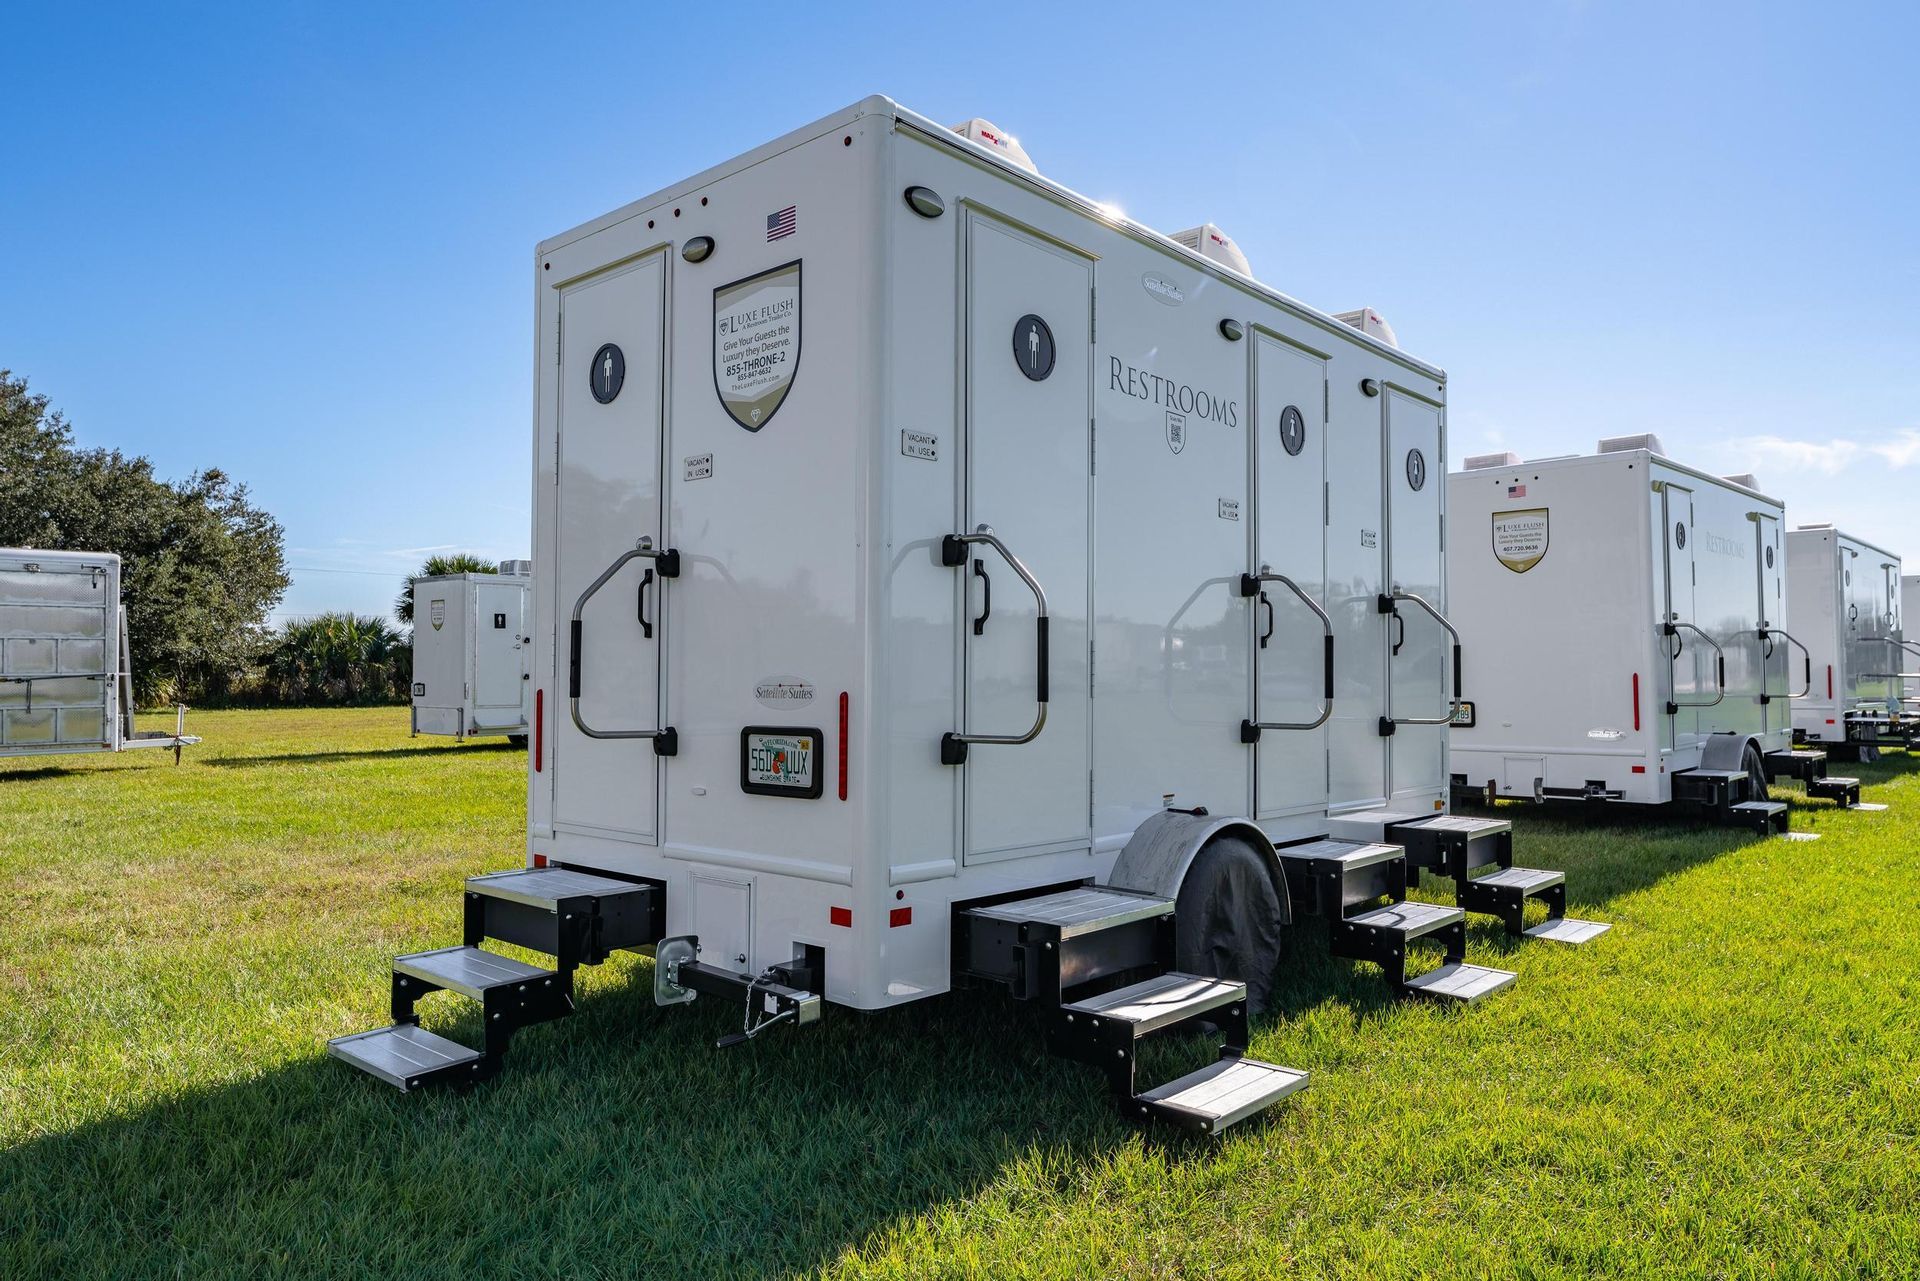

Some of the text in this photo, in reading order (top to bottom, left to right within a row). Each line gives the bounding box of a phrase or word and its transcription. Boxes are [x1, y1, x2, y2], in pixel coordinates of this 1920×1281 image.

[730, 298, 793, 333] LUXE FLUSH
[723, 325, 790, 351] Give Your Guests the
[722, 338, 791, 363] Luxury they Deserve.
[726, 351, 786, 376] 855-THRONE-2
[737, 366, 772, 382] 855-847-6632
[731, 374, 780, 391] TheLuxeFlush.com
[1109, 355, 1237, 428] RESTROOMS
[908, 433, 931, 445] VACANT
[908, 445, 931, 457] IN USE
[687, 457, 705, 467] VACANT
[695, 468, 705, 476] USE
[1503, 523, 1521, 532] LUXE
[1523, 521, 1544, 530] FLUSH
[755, 686, 813, 700] Satellite Suites
[751, 748, 772, 772] 56D
